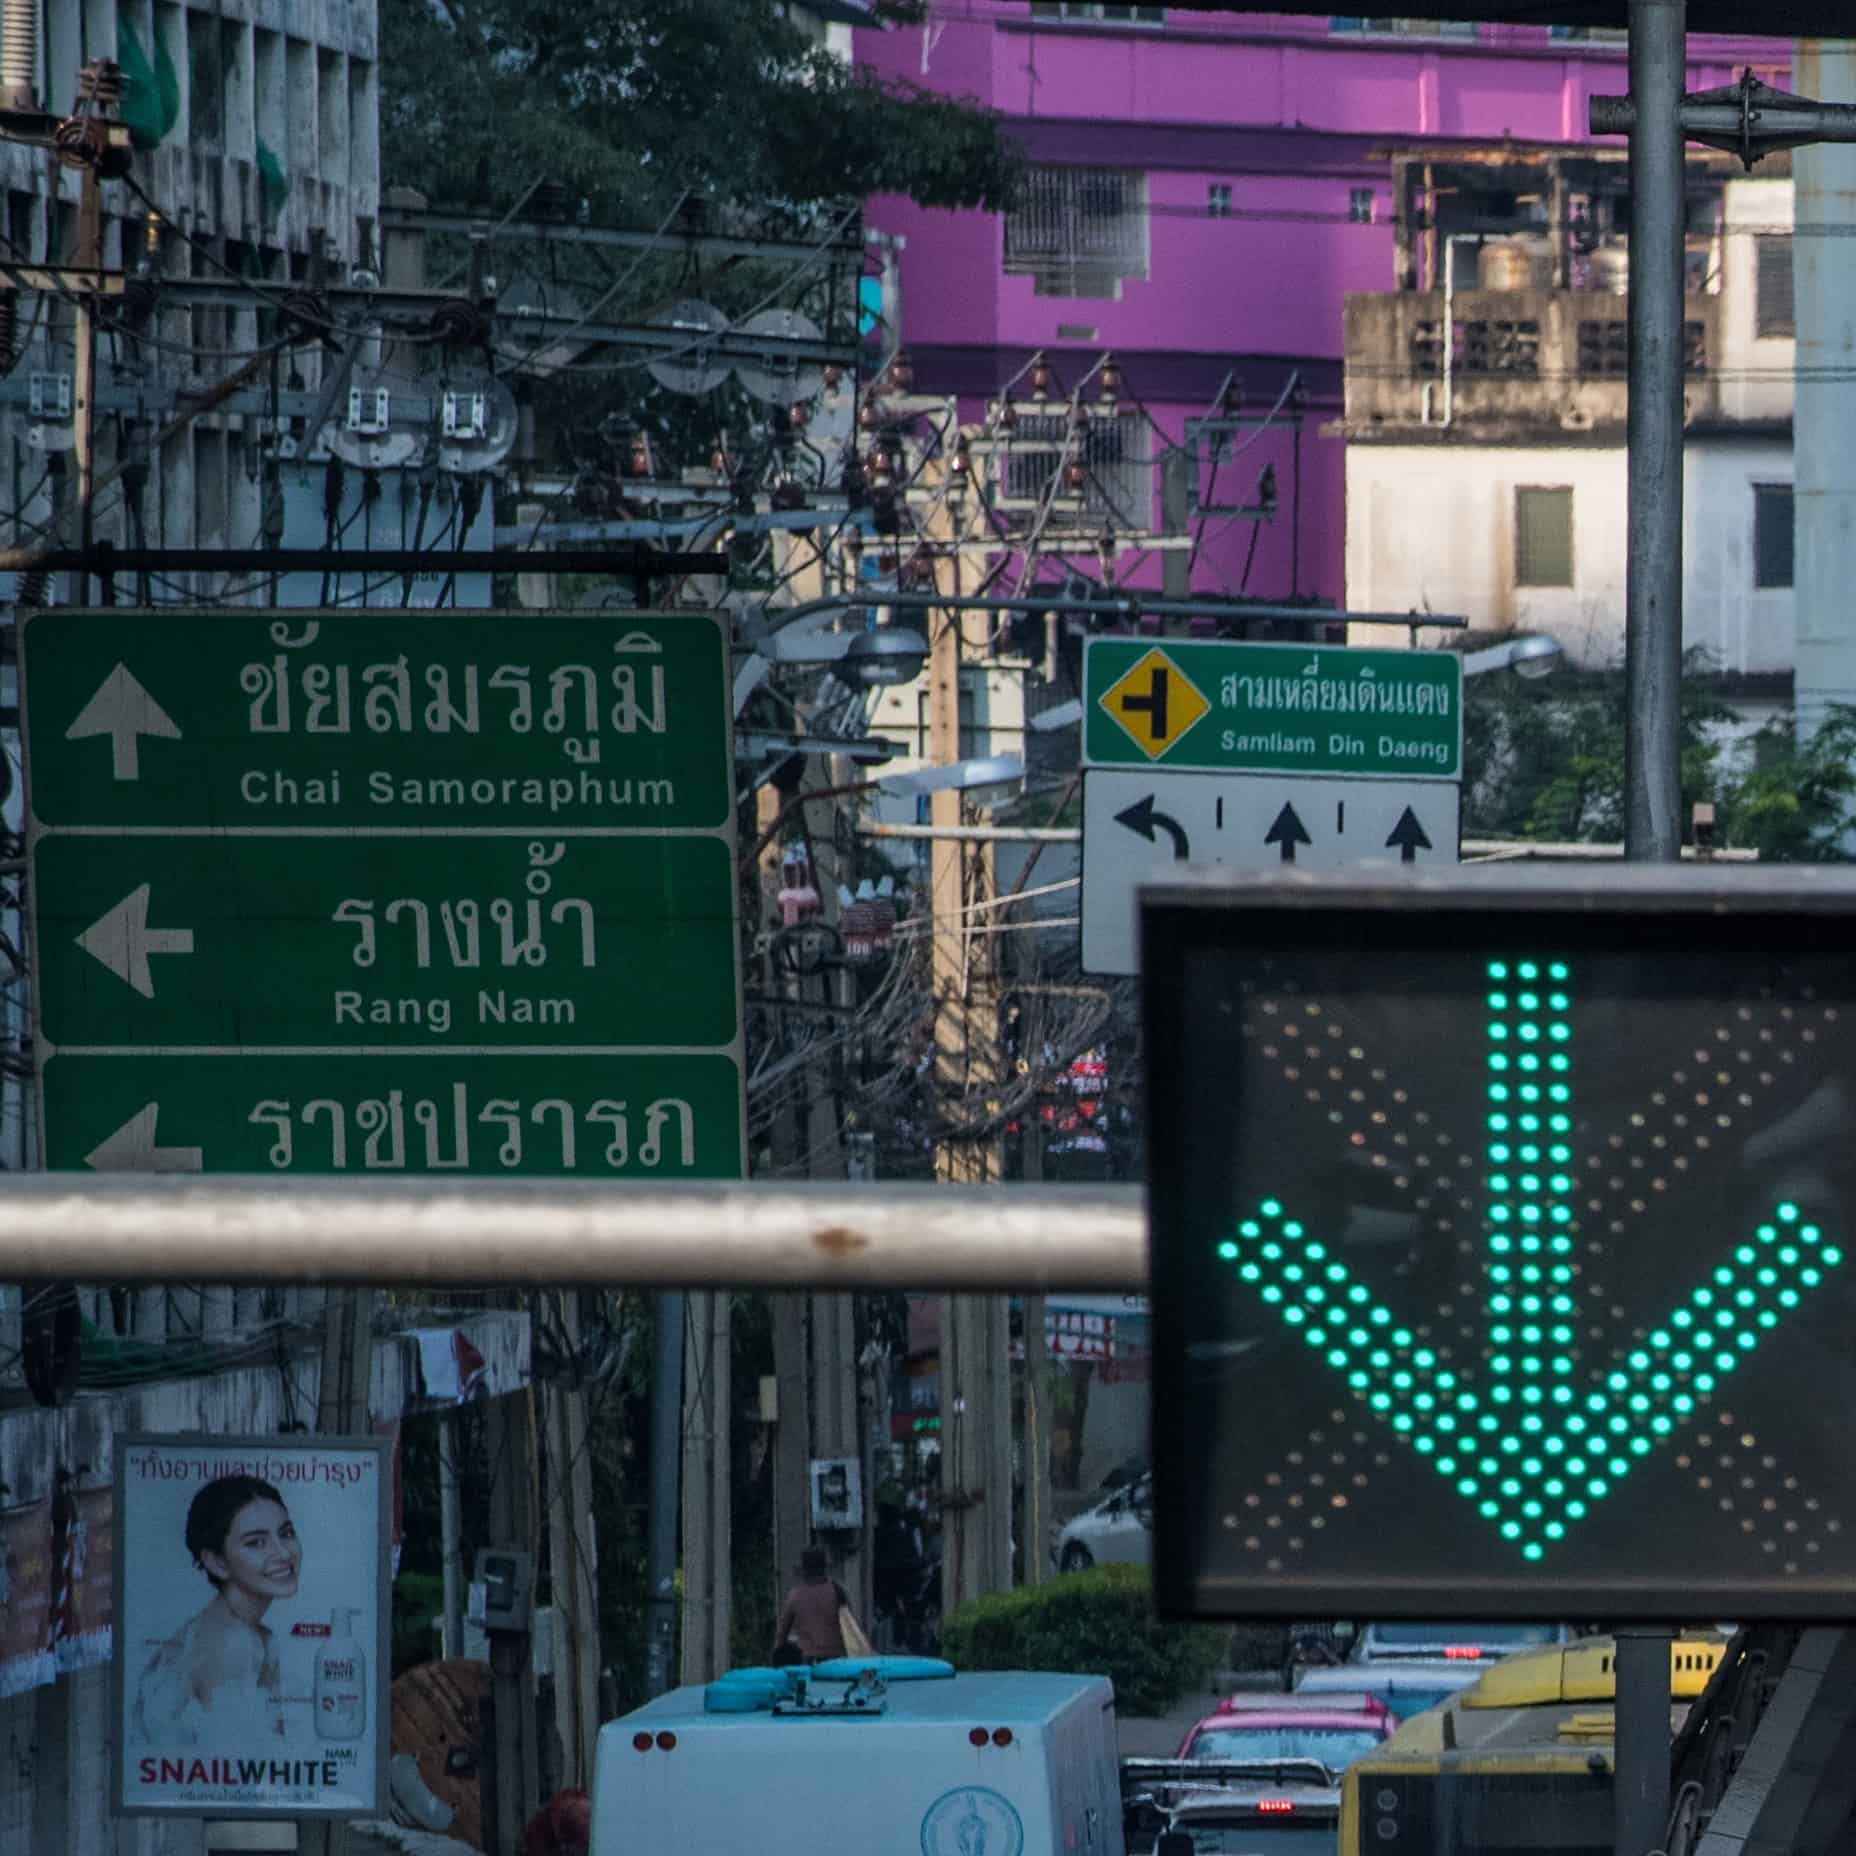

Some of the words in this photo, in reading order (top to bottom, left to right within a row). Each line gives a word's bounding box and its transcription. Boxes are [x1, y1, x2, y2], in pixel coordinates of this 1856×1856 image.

[239, 621, 667, 763] ชัยสมรภูมิ
[1219, 655, 1450, 717] สามเหลี่ยมดินแดง
[1220, 730, 1316, 755] Samliam
[1328, 733, 1364, 757] Din
[1378, 736, 1449, 763] Daeng
[240, 771, 342, 804] Chai
[368, 772, 674, 811] Samoraphum
[332, 841, 596, 968] รางน้ำ
[336, 991, 451, 1032] Rang
[479, 991, 576, 1023] Nam
[249, 1082, 695, 1168] ราชปรารภ
